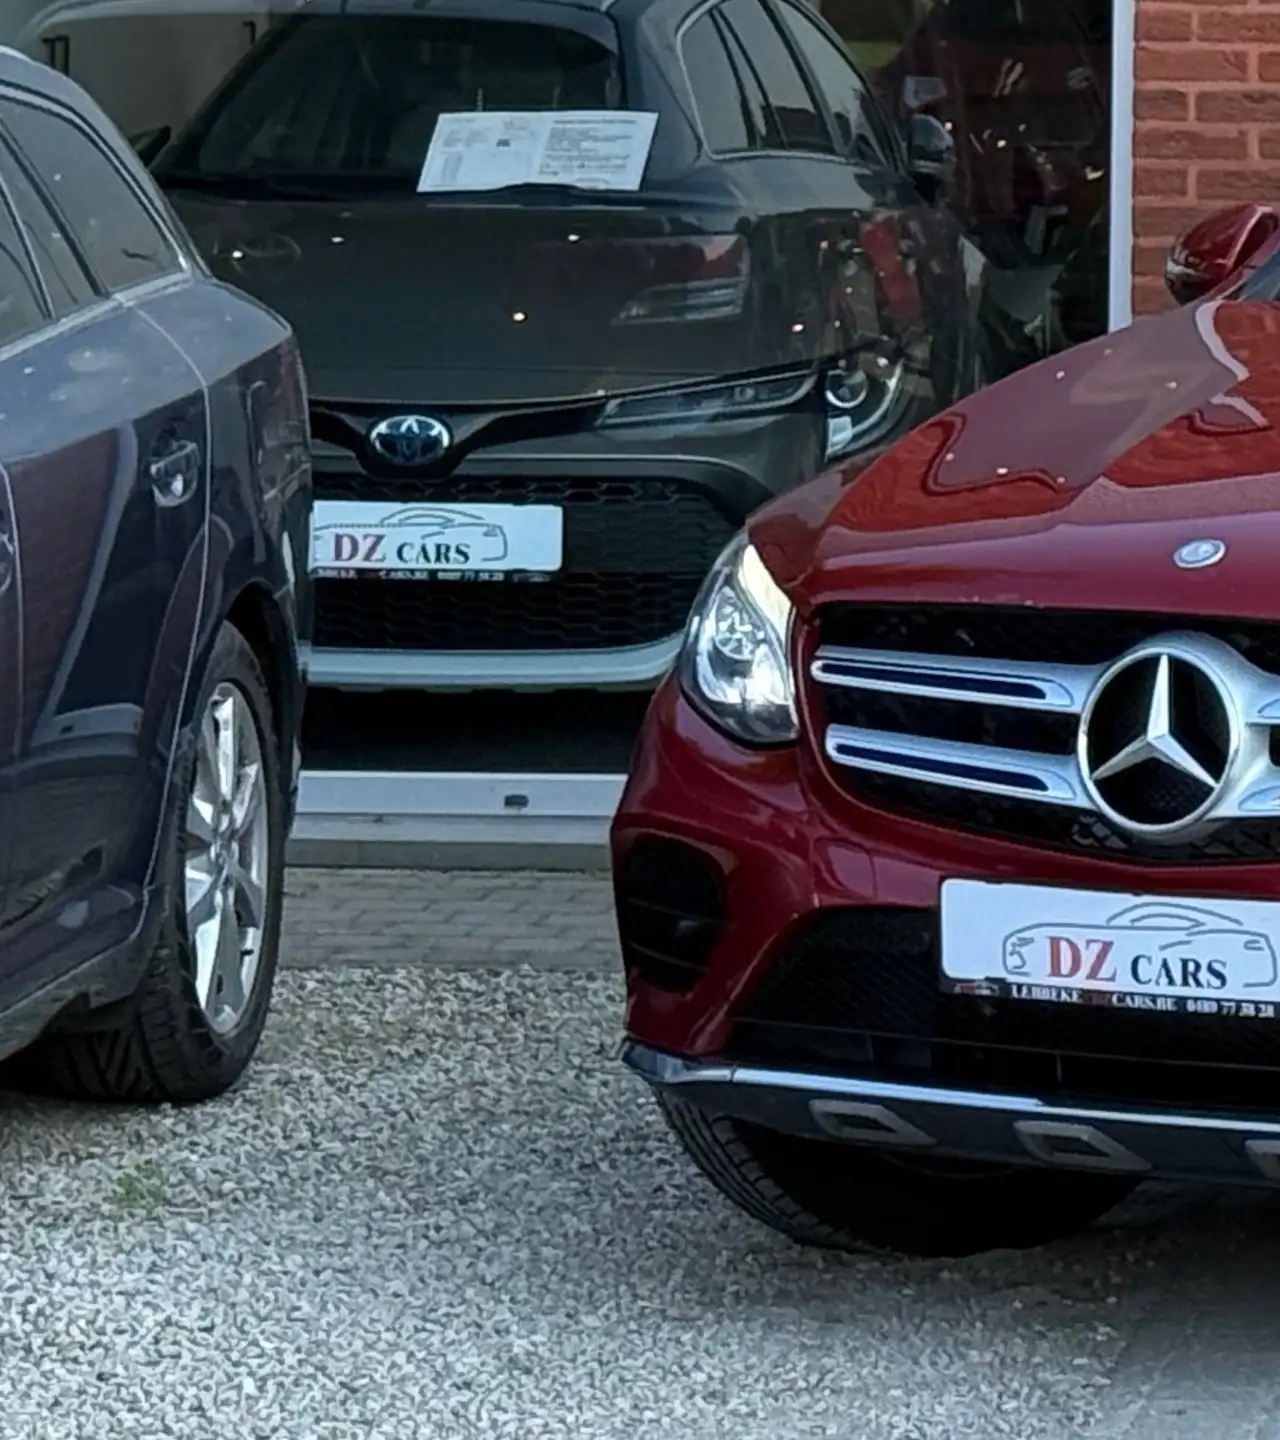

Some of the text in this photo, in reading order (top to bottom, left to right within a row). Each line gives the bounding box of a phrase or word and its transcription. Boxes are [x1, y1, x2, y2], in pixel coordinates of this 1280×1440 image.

[334, 533, 471, 565] DZ CARS
[1045, 936, 1228, 990] DZ CARS
